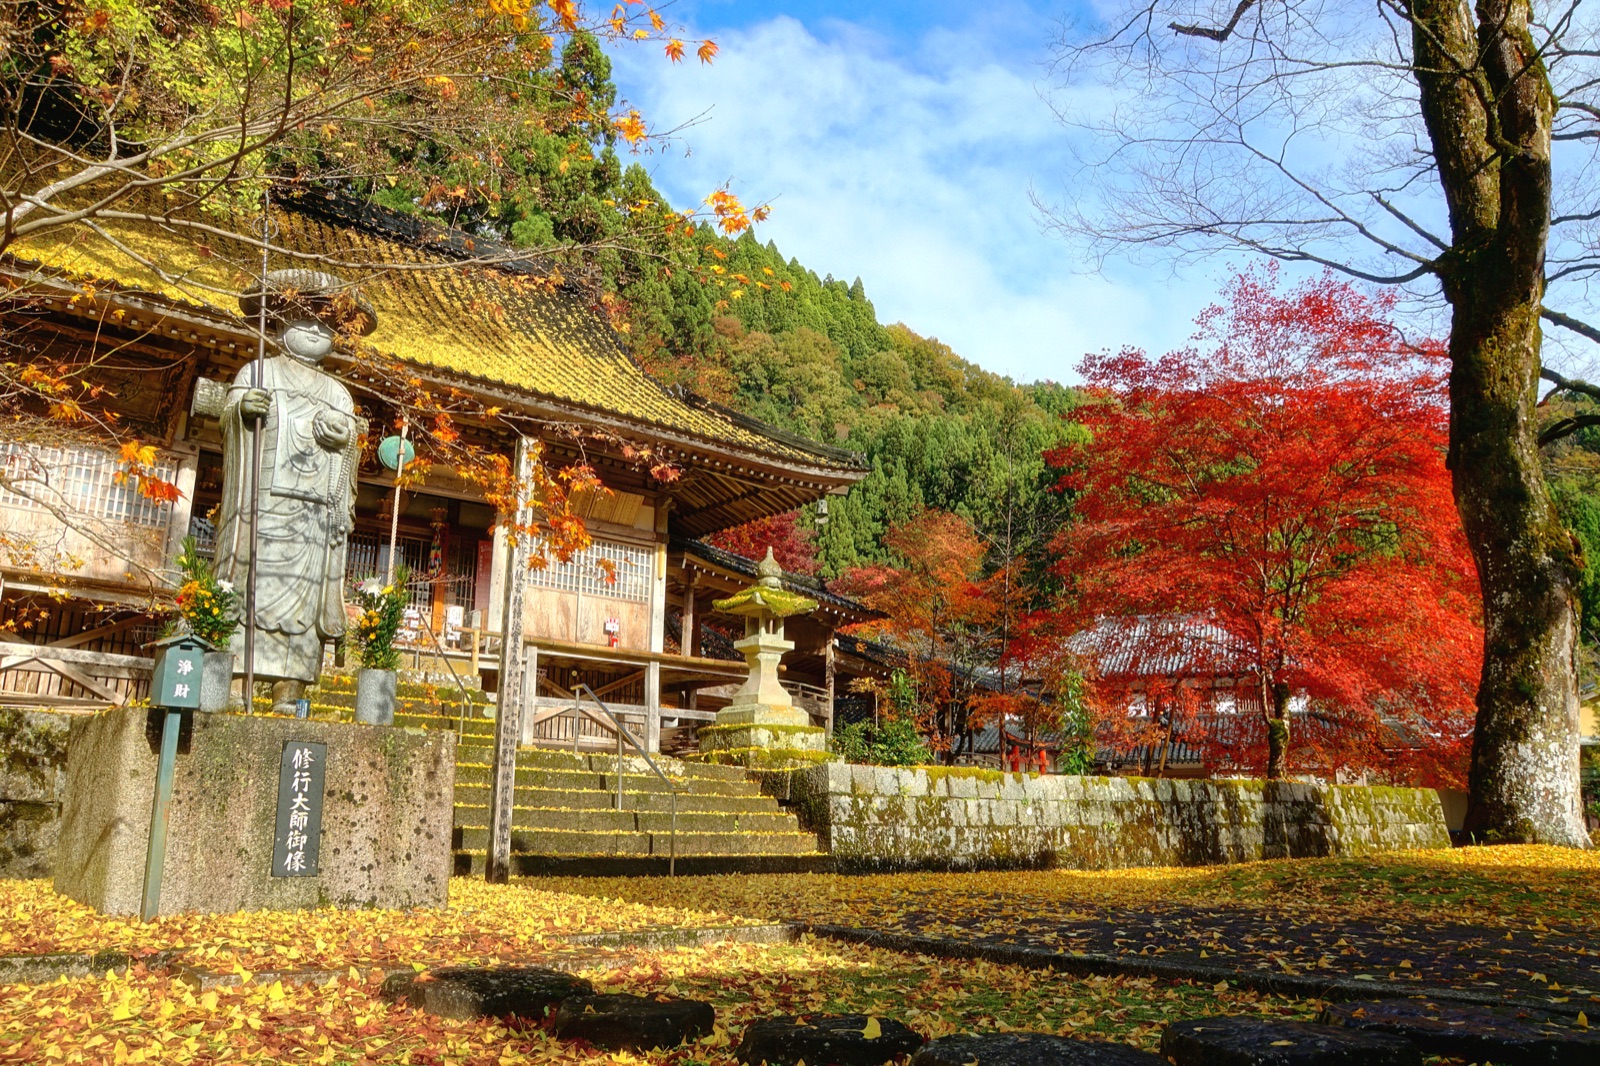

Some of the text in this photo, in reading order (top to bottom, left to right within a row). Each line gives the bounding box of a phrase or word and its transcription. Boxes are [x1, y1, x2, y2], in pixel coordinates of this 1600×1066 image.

[284, 748, 314, 872] 修行大師御像
